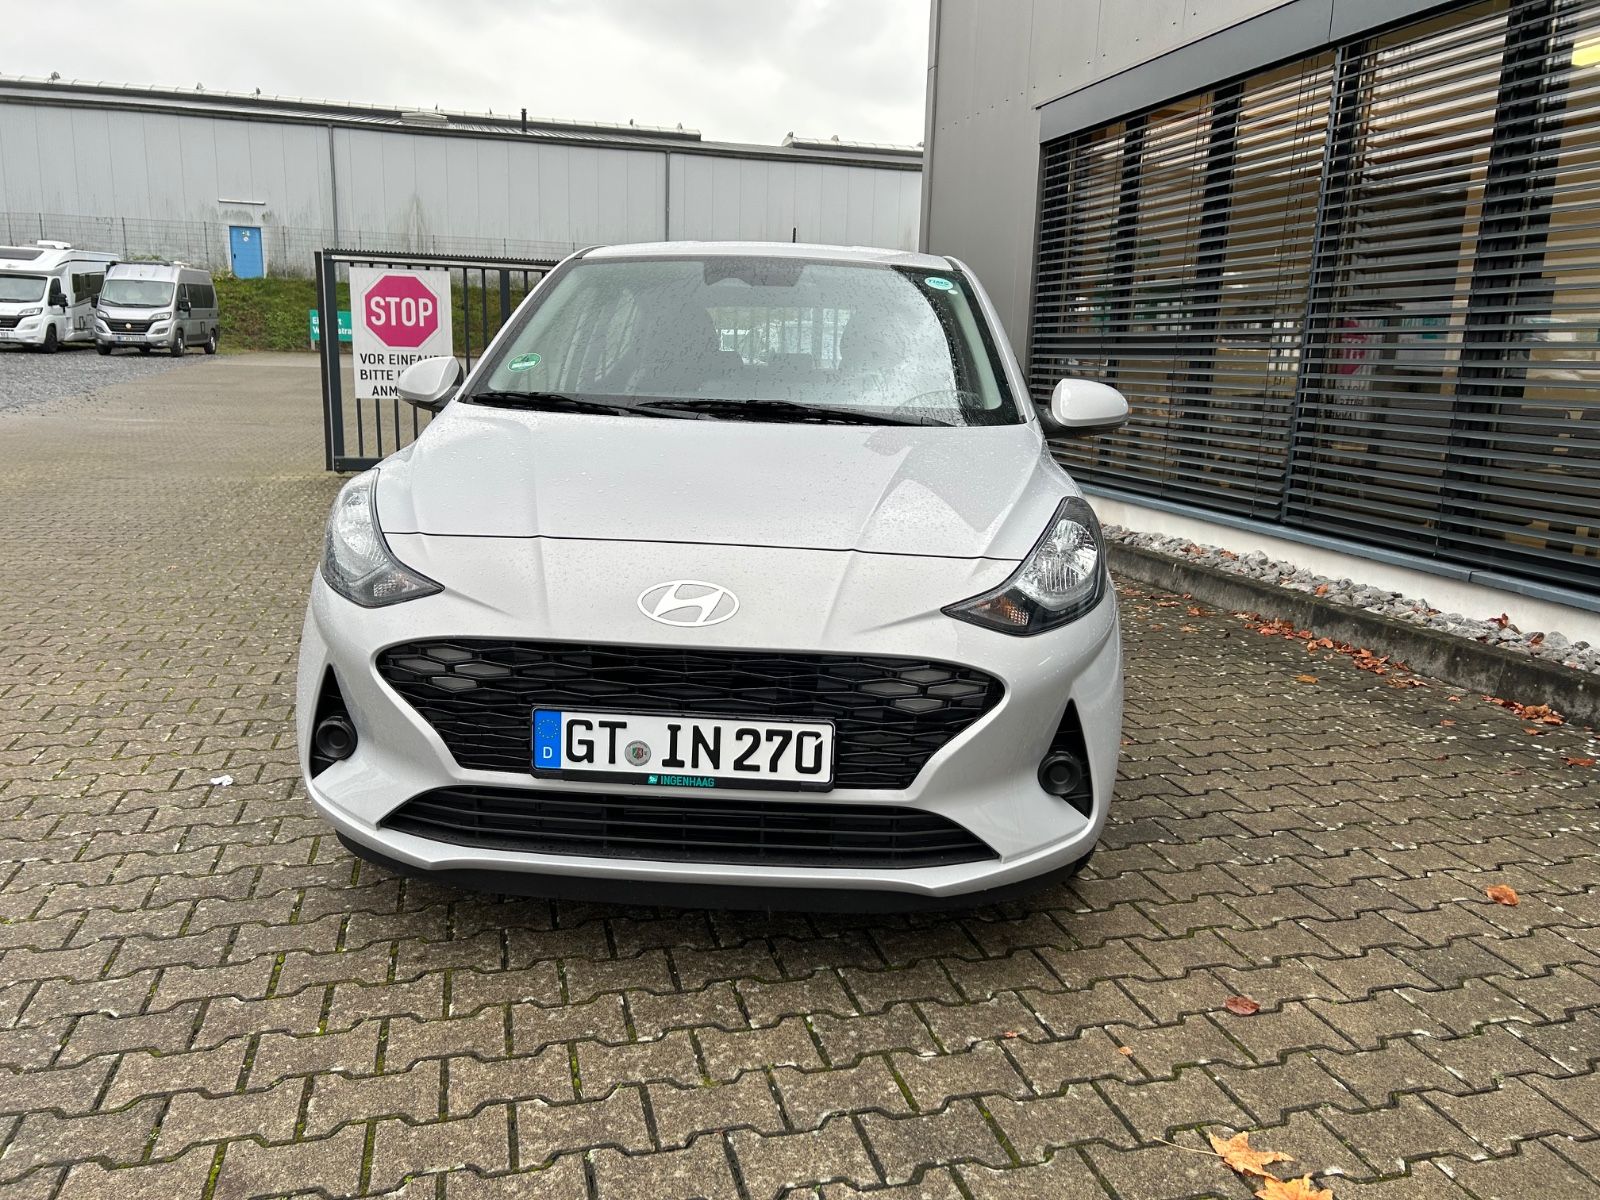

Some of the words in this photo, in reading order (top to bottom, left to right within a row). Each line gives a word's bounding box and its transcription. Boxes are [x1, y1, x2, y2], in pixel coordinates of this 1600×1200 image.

[370, 296, 433, 327] STOP
[360, 353, 385, 365] VOR
[360, 369, 394, 381] BITTE
[566, 719, 627, 764] GT
[543, 746, 553, 758] D
[660, 775, 715, 787] INGENHAAG
